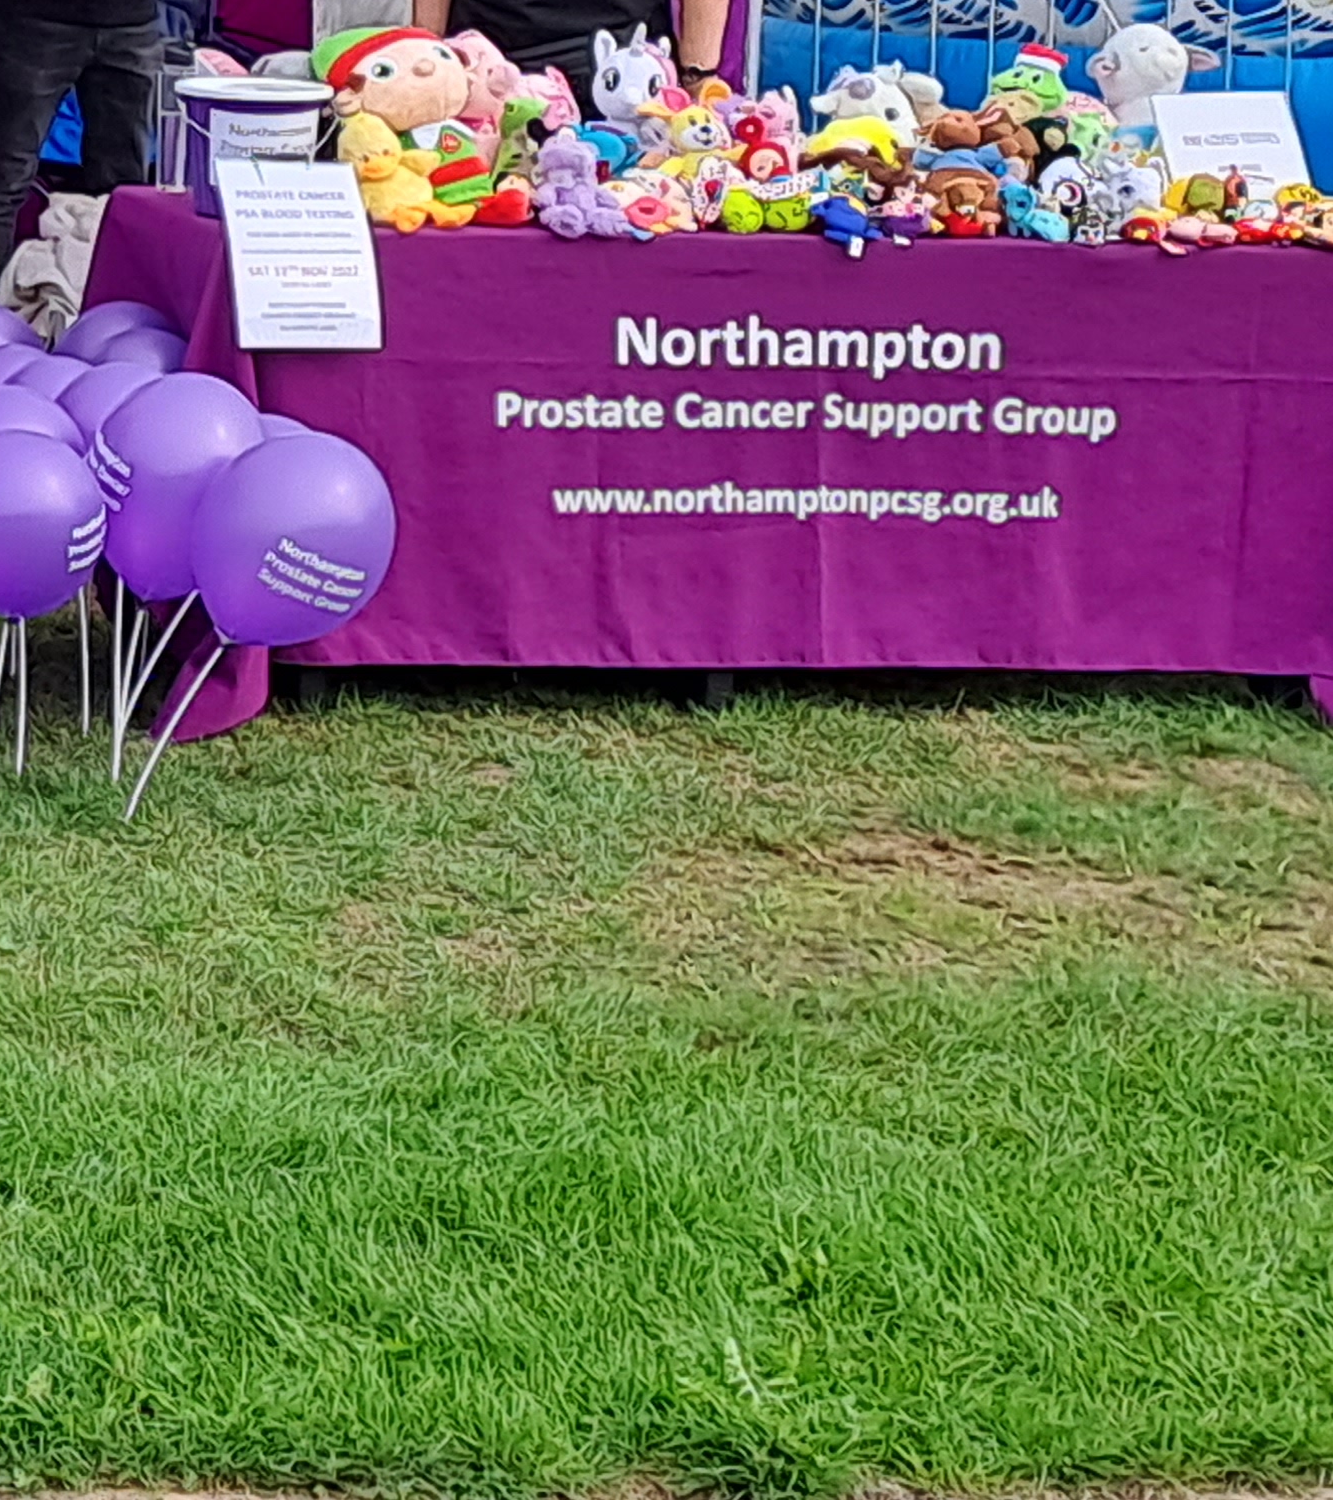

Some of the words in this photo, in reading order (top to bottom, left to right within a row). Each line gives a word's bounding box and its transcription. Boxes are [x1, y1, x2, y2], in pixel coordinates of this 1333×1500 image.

[235, 189, 295, 200] PROSTATE
[298, 190, 346, 201] CANCER
[235, 208, 257, 219] PSA
[261, 208, 302, 219] BLOOD
[616, 313, 1002, 380] Northampton
[496, 391, 665, 429] Prostate
[674, 392, 815, 429] Cancer
[823, 393, 984, 439] Support
[992, 396, 1118, 443] Group
[552, 481, 1060, 524] www.northamptonpcsg.org.uk
[263, 550, 321, 588] Prostate
[278, 538, 365, 580] Northampton
[257, 568, 313, 603] Support
